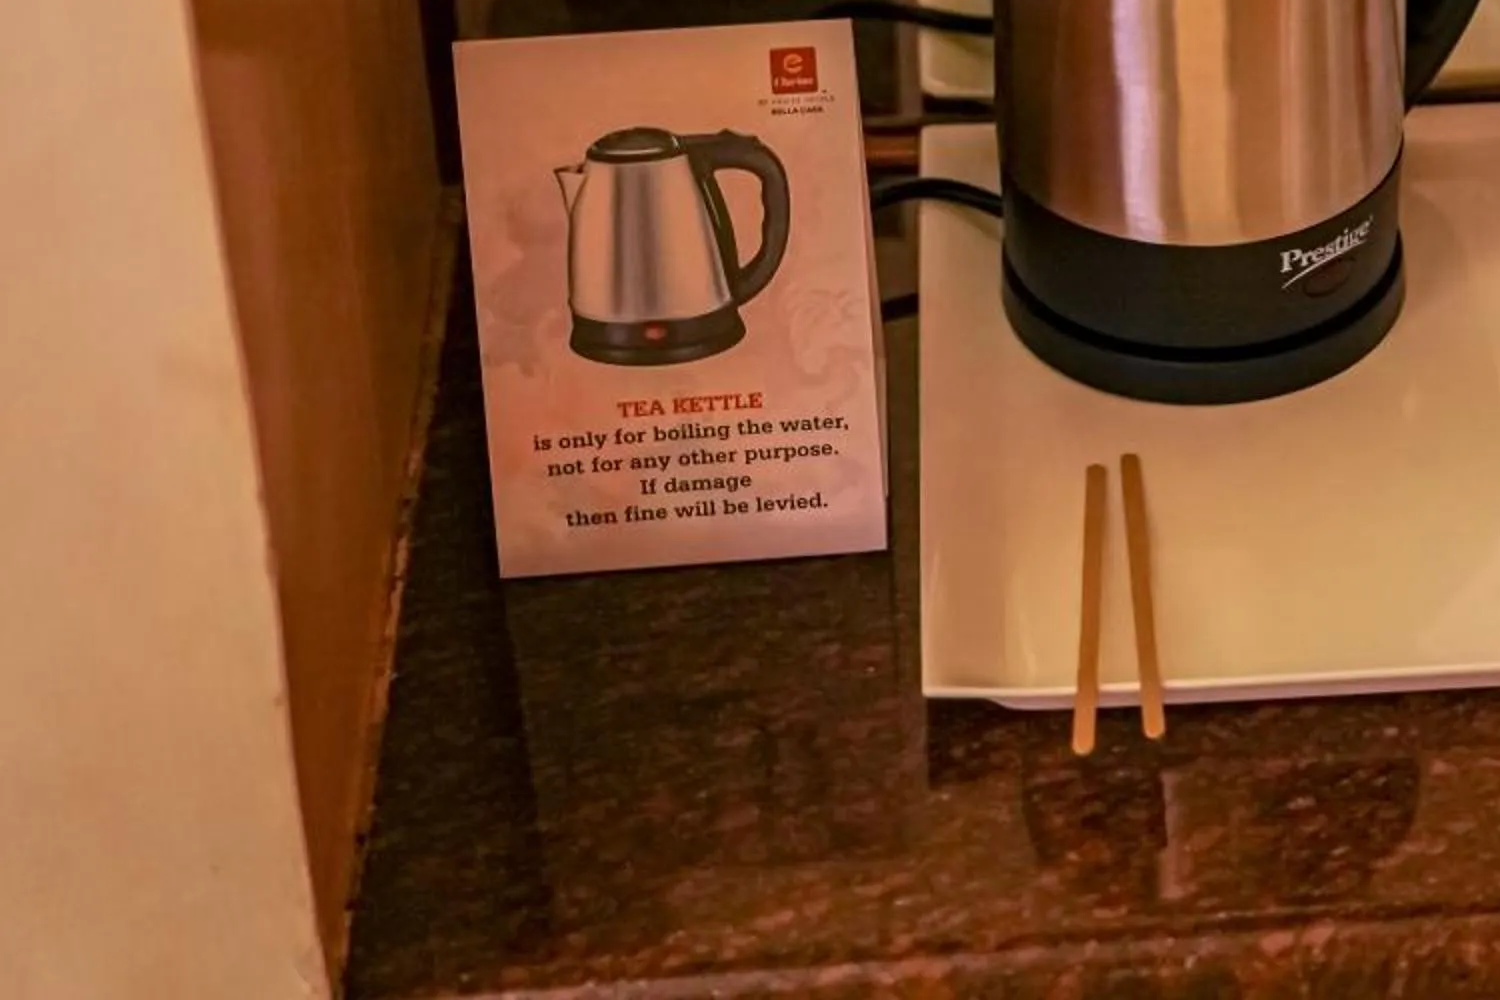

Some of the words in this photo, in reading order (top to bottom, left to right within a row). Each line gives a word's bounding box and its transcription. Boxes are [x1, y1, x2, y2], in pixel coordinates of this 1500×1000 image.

[1279, 218, 1374, 274] Prestige
[616, 399, 665, 418] TEA
[672, 392, 763, 414] KETTLE
[533, 434, 552, 451] is
[558, 431, 607, 449] only
[614, 428, 647, 445] for
[653, 422, 731, 442] boiling
[737, 418, 773, 435] the
[780, 415, 849, 433] water,
[547, 459, 585, 477] not
[591, 456, 623, 473] for
[629, 455, 671, 472] any
[678, 448, 737, 466] other
[744, 442, 840, 465] purpose.
[640, 478, 657, 495] If
[663, 474, 752, 493] damage
[566, 509, 618, 527] then
[624, 504, 668, 522] fine
[674, 500, 716, 518] will
[723, 499, 749, 515] be
[755, 491, 829, 513] levied.
